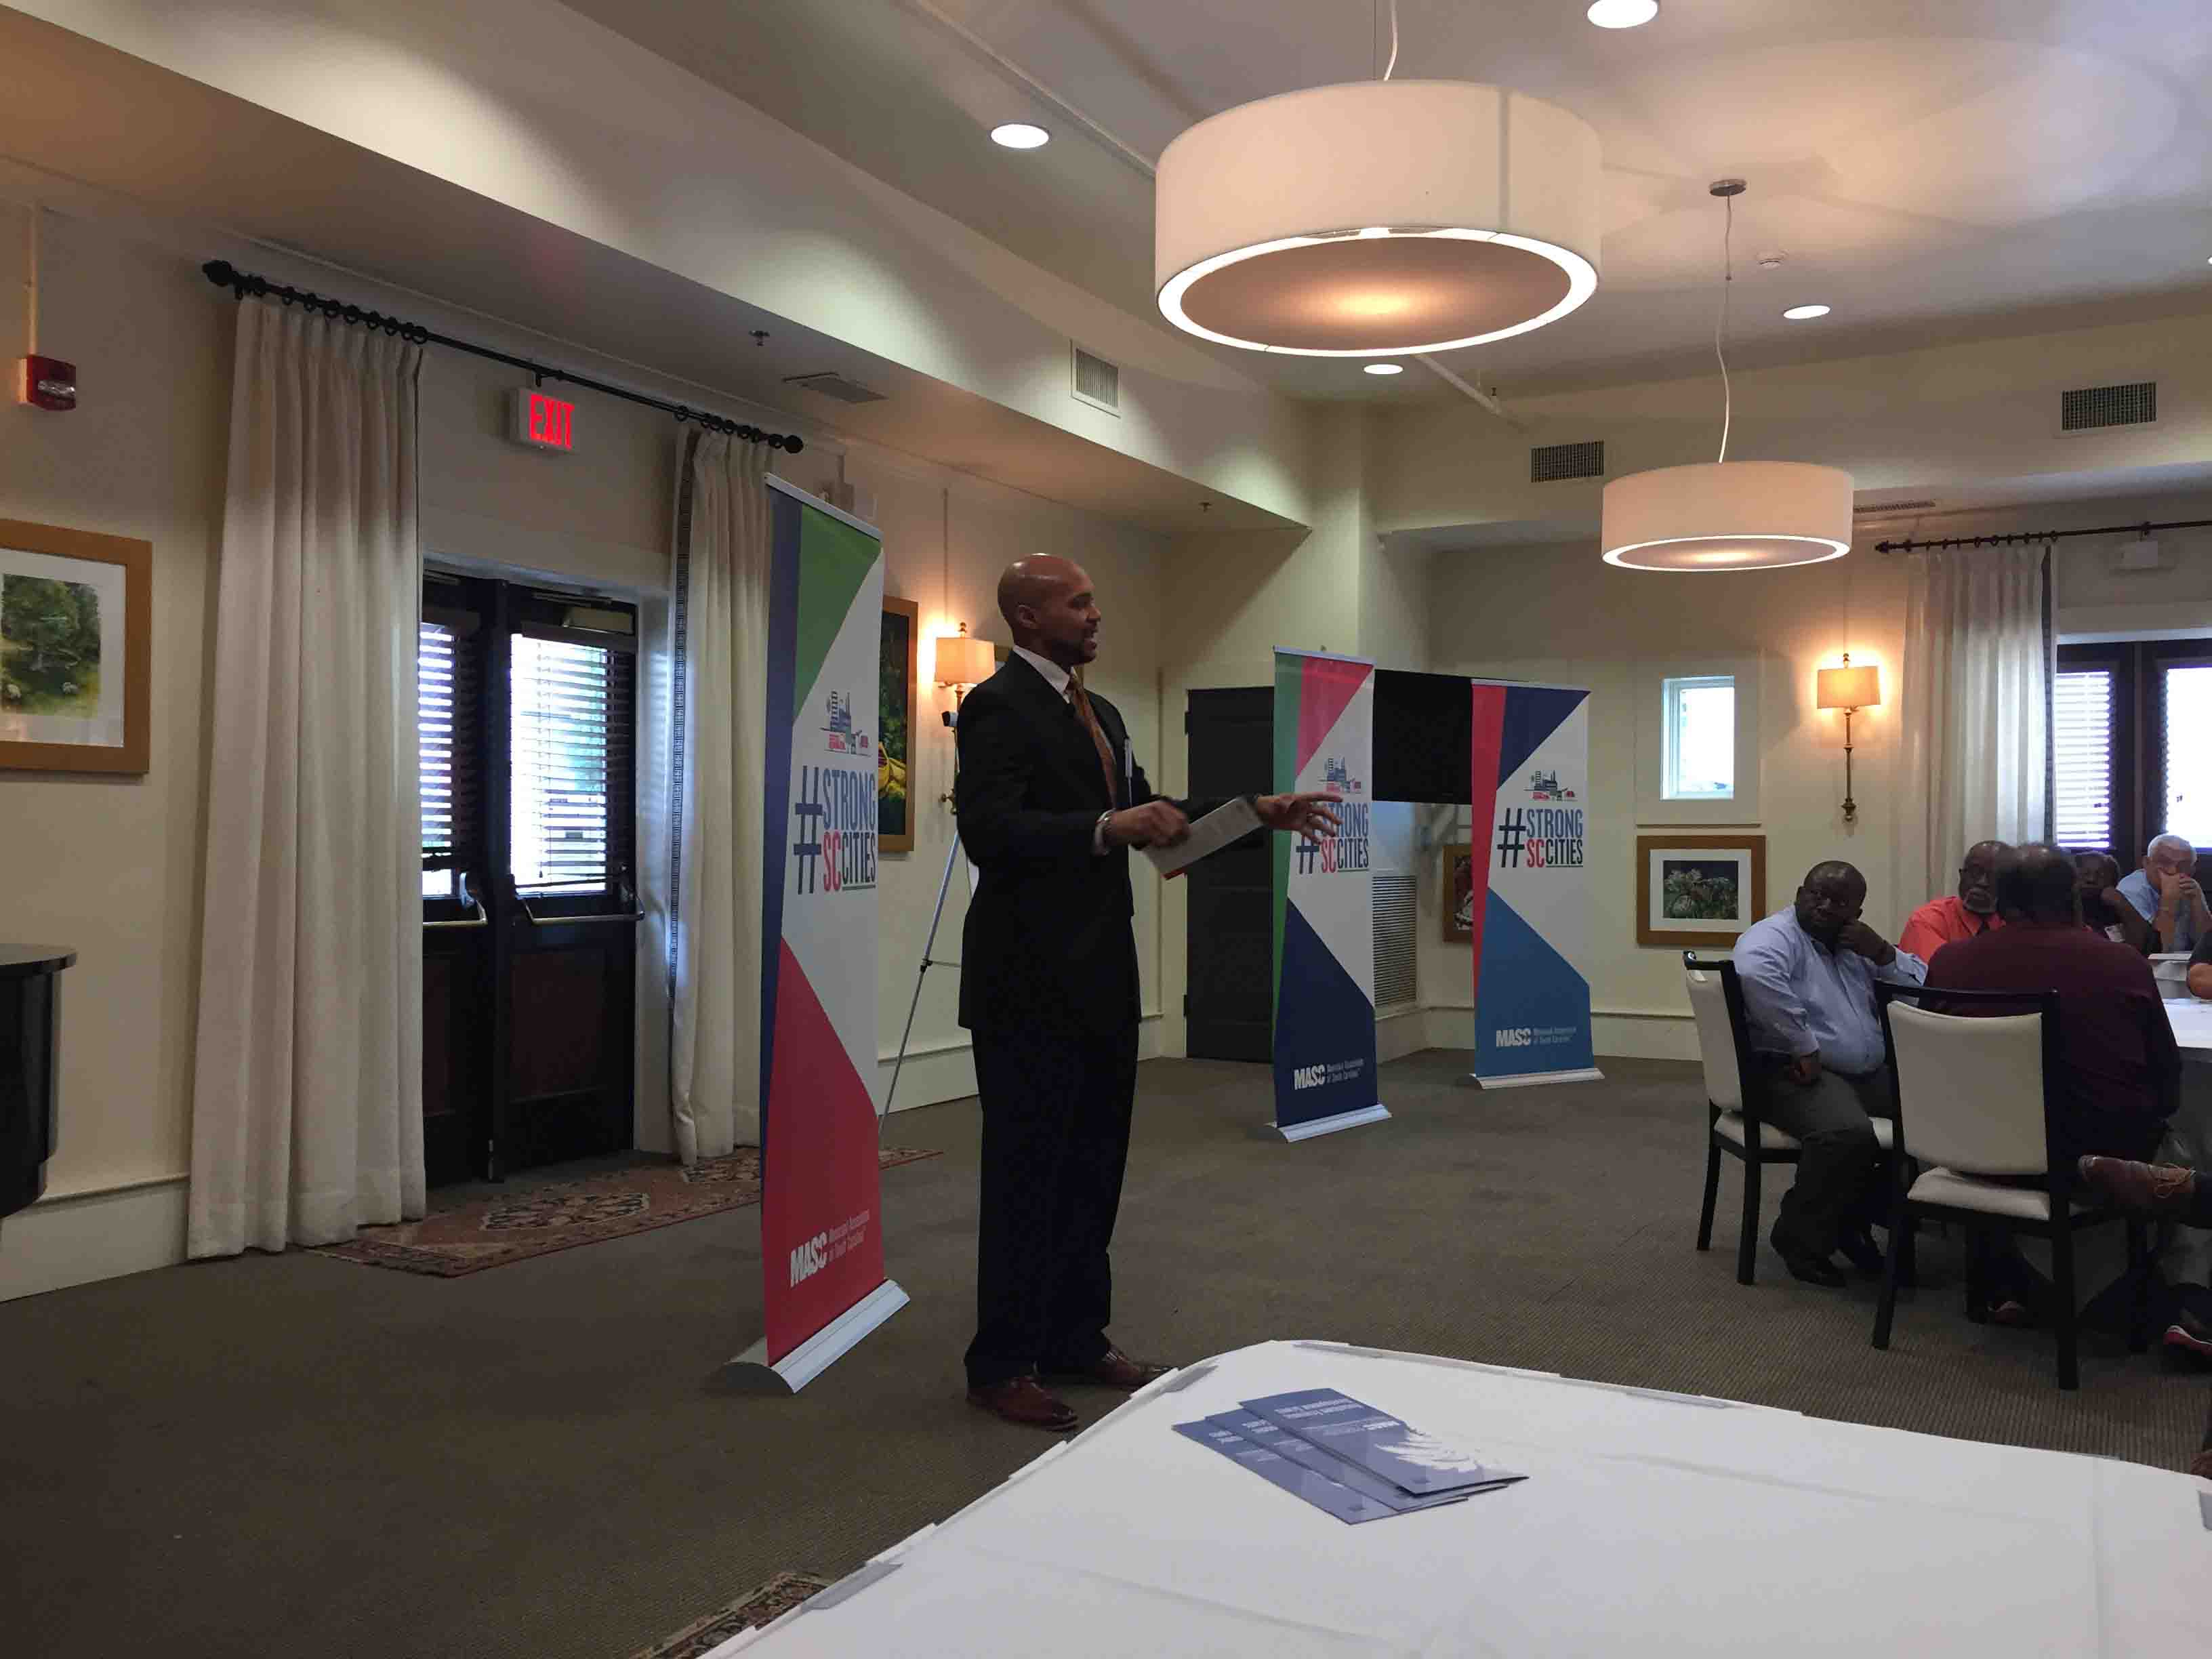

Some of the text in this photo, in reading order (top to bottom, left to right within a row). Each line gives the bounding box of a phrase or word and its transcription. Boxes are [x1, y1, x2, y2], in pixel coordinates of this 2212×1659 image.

[530, 393, 575, 450] EXIT
[1496, 1028, 1531, 1047] MASC
[1294, 1064, 1325, 1090] MASC
[791, 1231, 827, 1288] MASC
